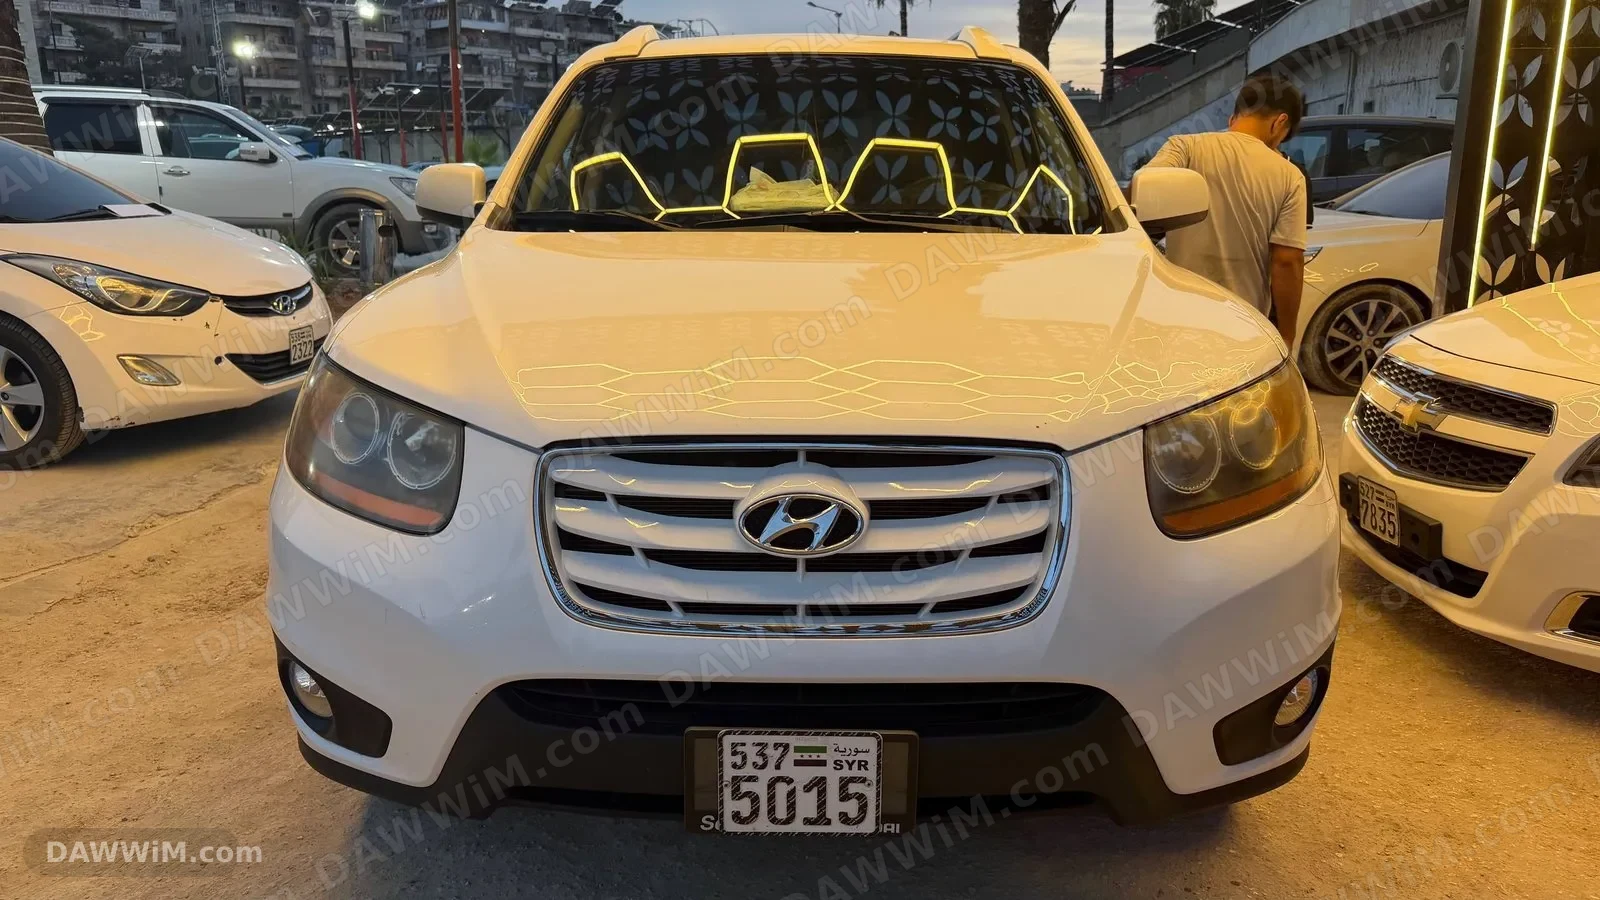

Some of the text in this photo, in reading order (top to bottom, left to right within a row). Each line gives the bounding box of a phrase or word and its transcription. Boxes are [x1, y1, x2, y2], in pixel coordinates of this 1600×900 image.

[292, 339, 313, 361] 2322
[1360, 481, 1375, 500] 527
[1361, 499, 1396, 539] 7835
[730, 742, 790, 770] 537
[833, 743, 870, 756] سورية
[833, 760, 869, 771] SYR
[731, 775, 868, 826] 5015
